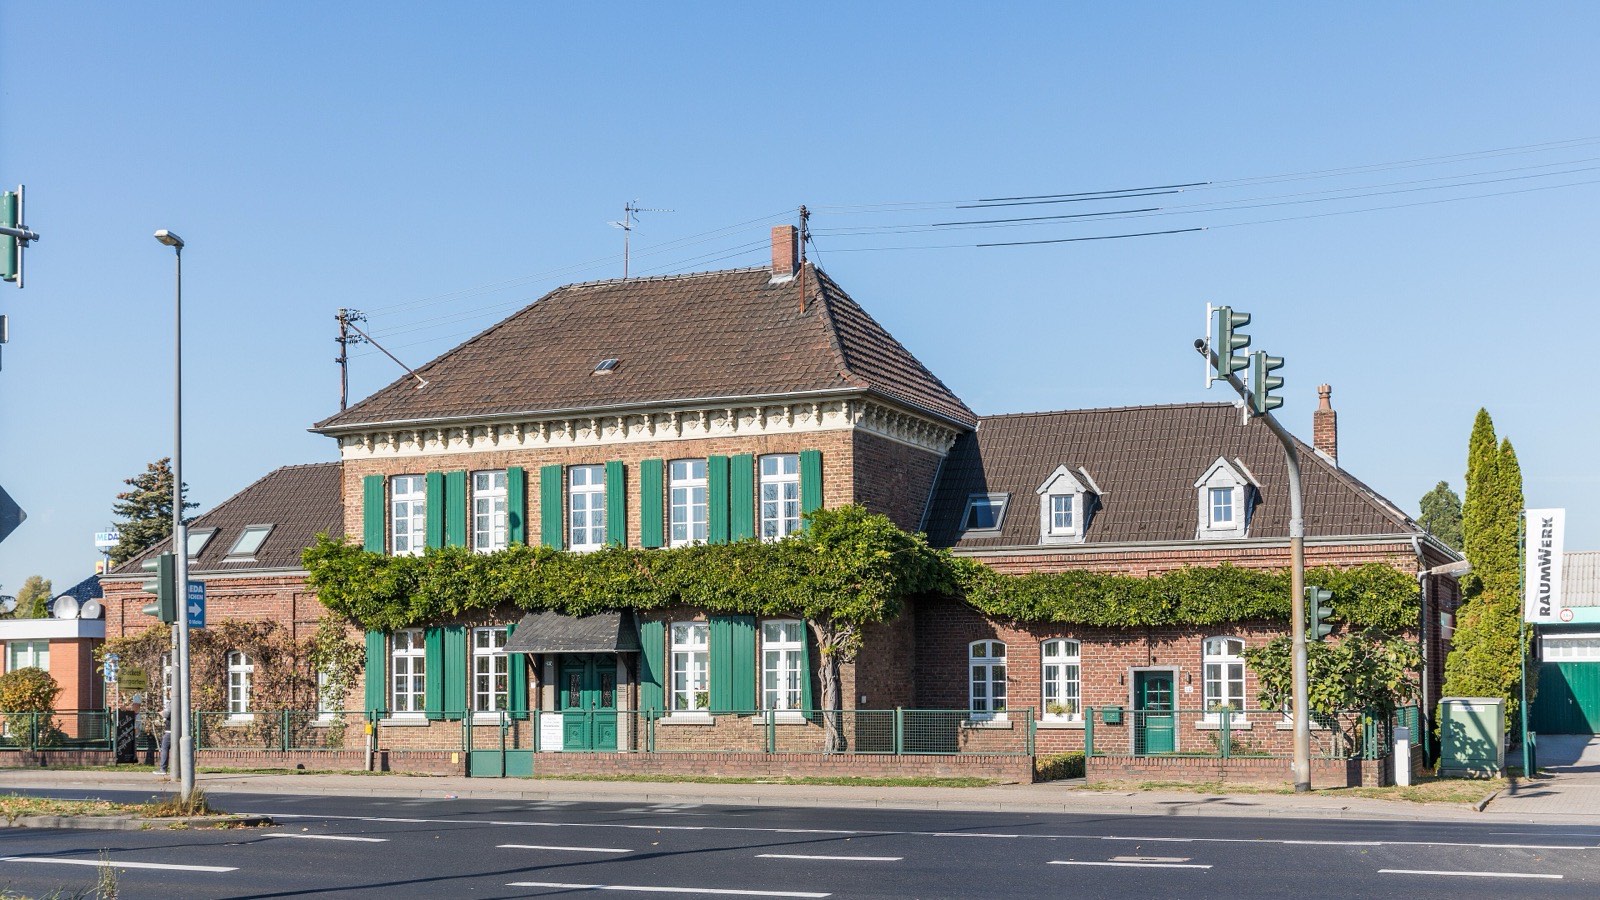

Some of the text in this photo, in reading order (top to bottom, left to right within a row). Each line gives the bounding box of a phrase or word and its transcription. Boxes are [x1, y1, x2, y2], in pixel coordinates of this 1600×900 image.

[97, 533, 118, 541] MEDA
[1538, 516, 1553, 617] RAUMWERK
[188, 585, 203, 593] EDA
